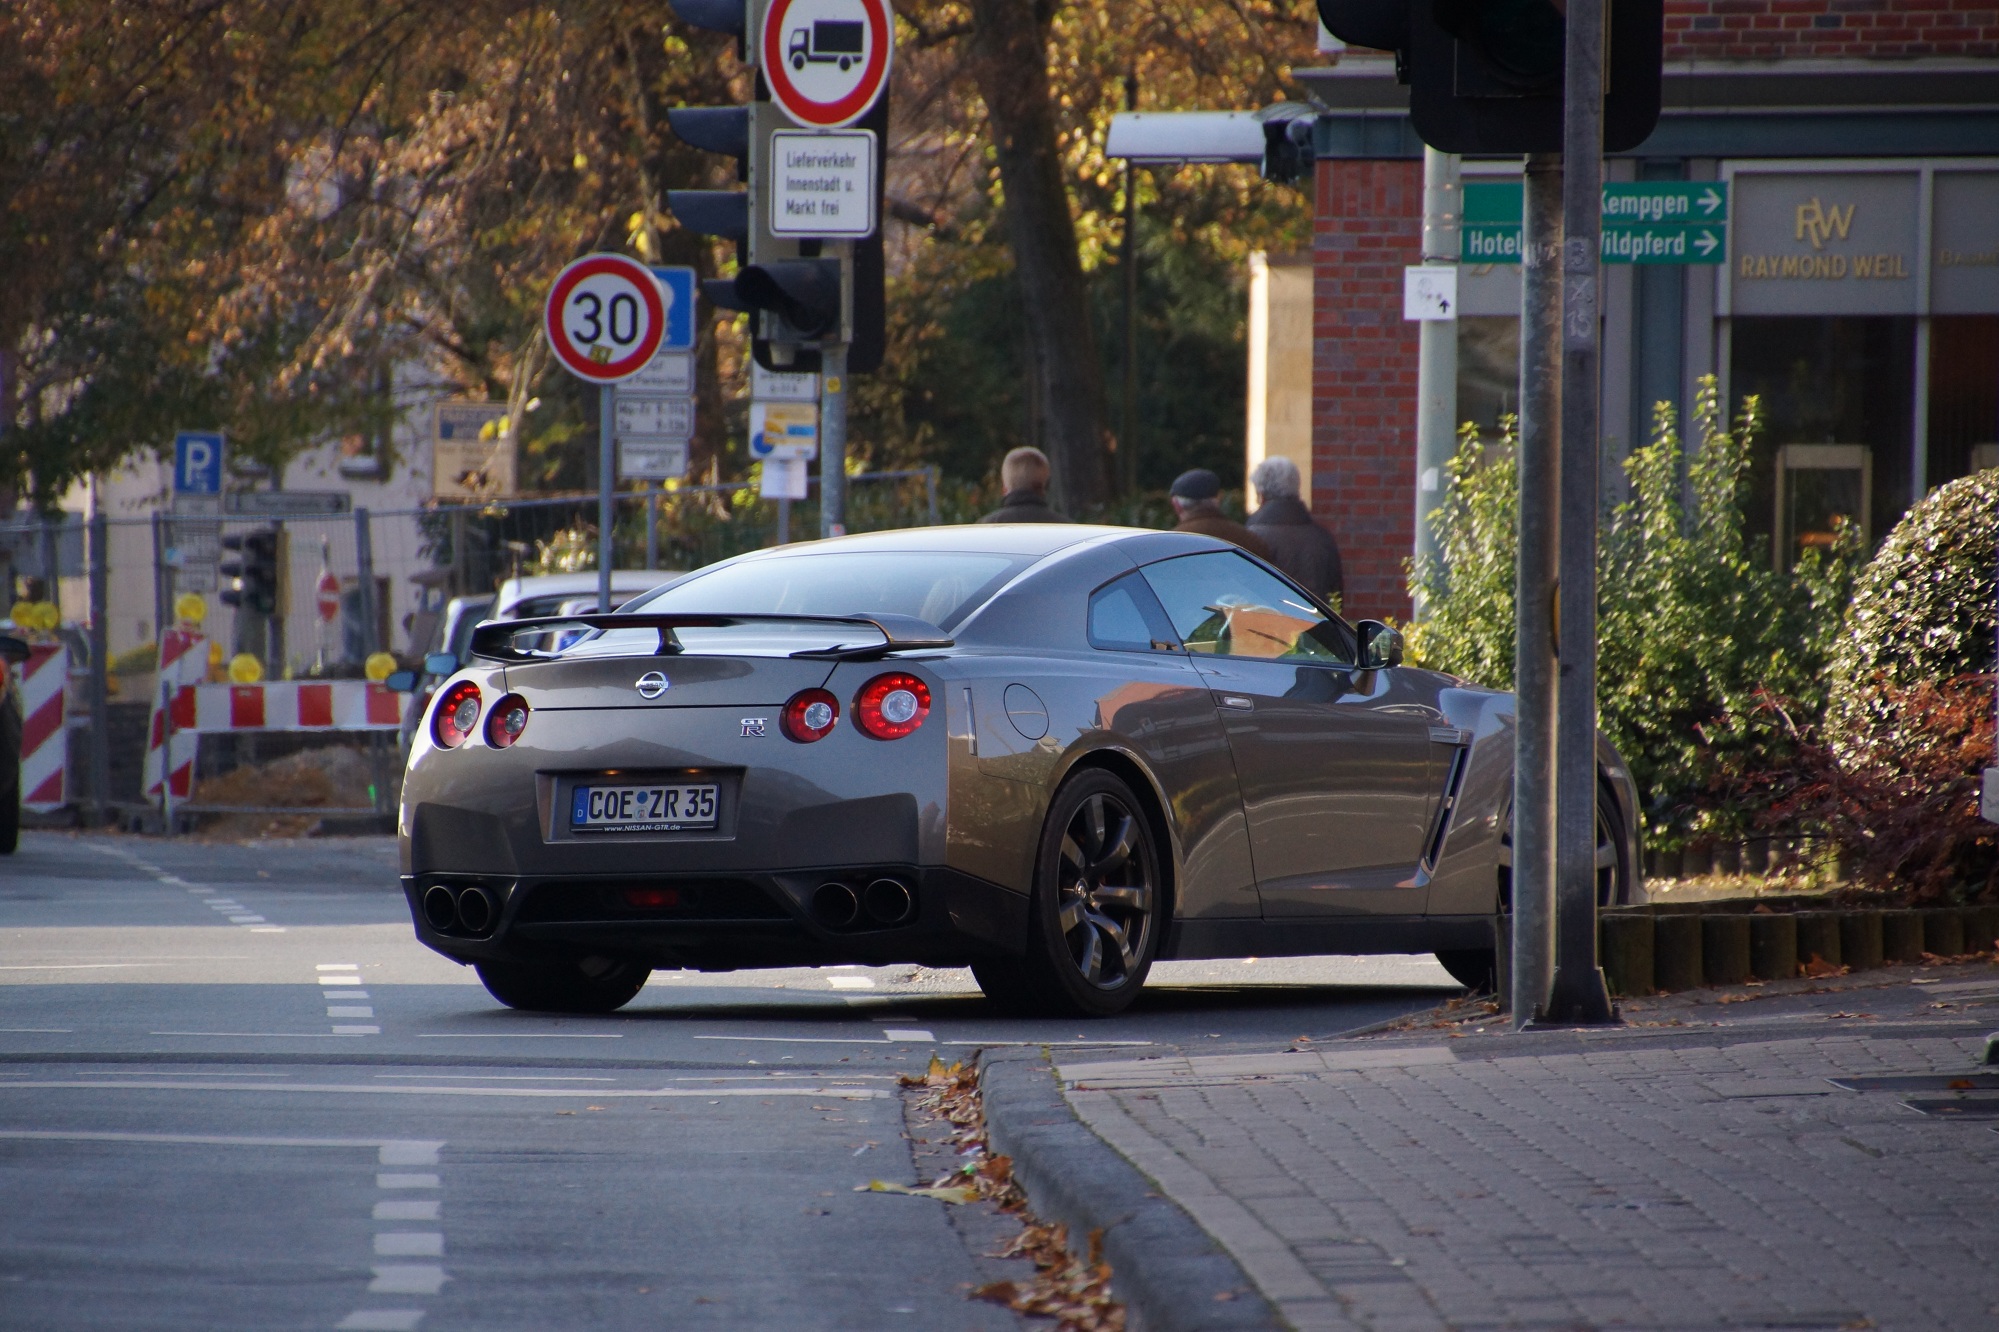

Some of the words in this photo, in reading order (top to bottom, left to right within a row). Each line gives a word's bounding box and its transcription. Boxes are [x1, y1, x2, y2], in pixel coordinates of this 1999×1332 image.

[786, 151, 857, 168] Lieferverkehr
[786, 175, 841, 191] Innenstadt
[845, 180, 855, 192] u.
[786, 199, 817, 215] Markt
[821, 199, 840, 215] frei
[1470, 230, 1522, 255] Hotel
[1601, 230, 1685, 261] ildpferd
[1740, 254, 1847, 279] RAYMOND
[1853, 254, 1909, 279] WEIL
[573, 290, 638, 346] 30
[184, 440, 212, 487] P
[588, 790, 634, 820] COE
[648, 789, 679, 819] ZR
[684, 788, 714, 818] 35
[603, 824, 681, 832] www.NISSAN-GTR.de
